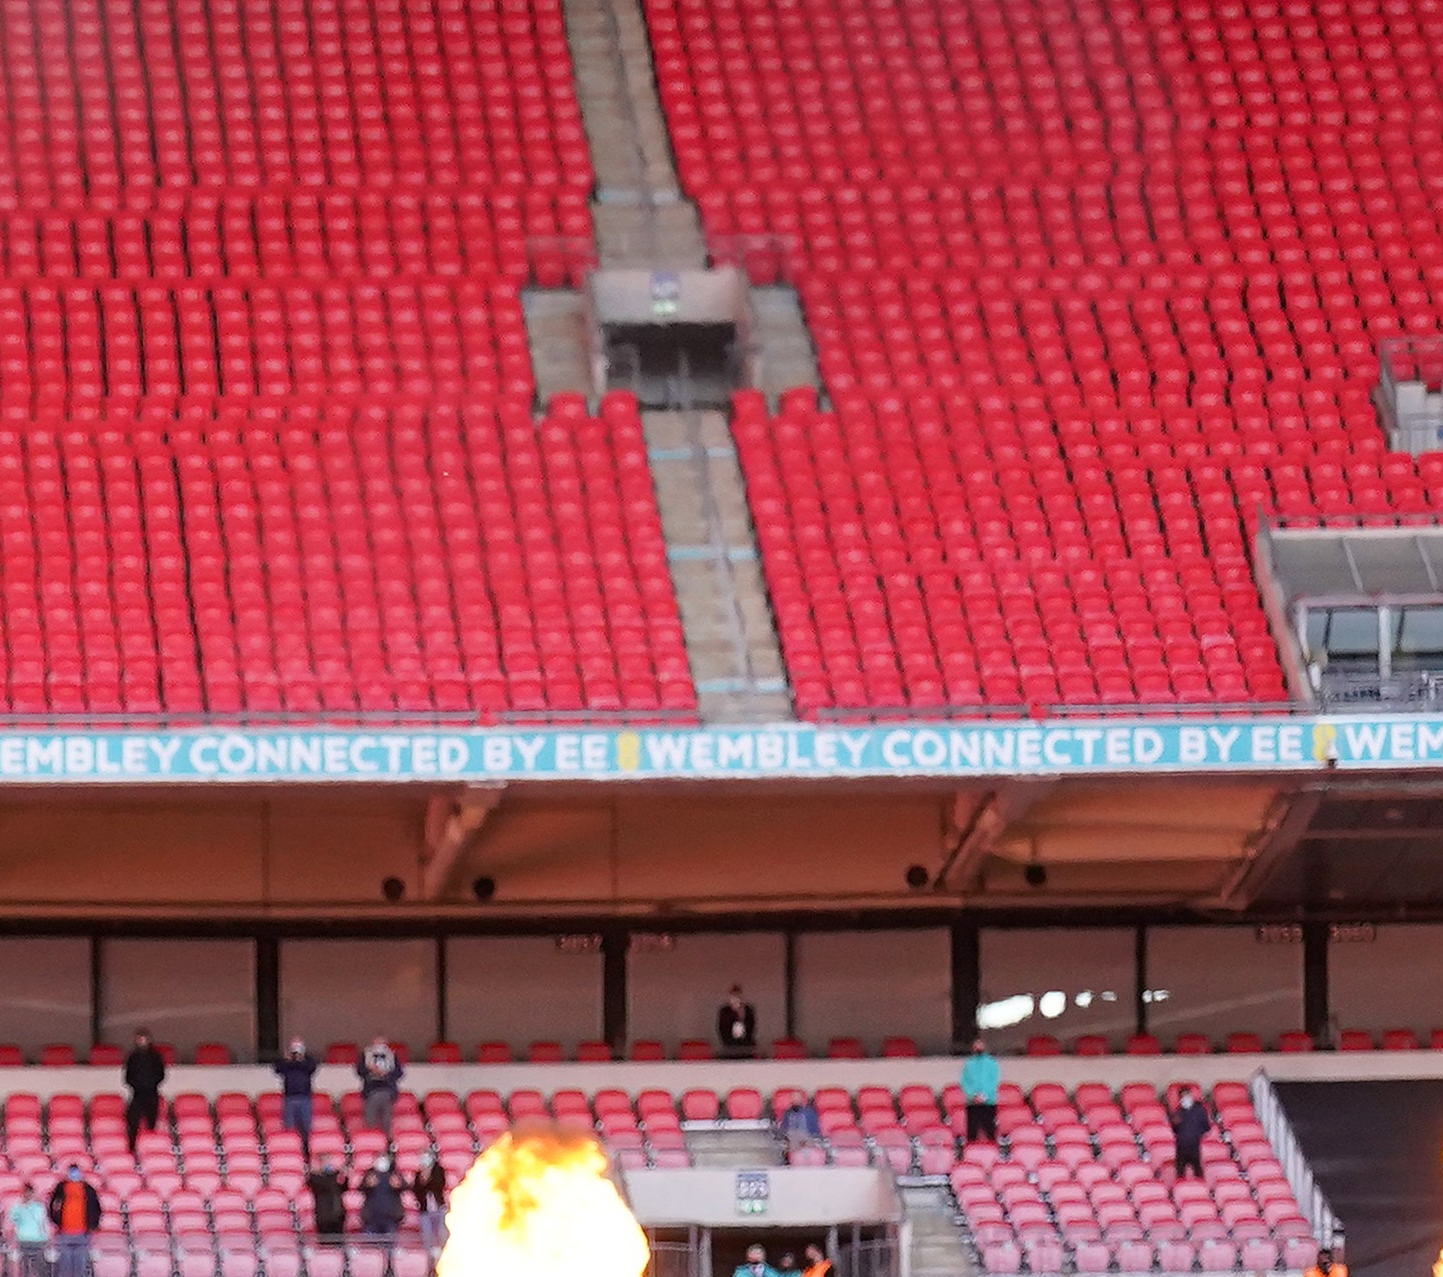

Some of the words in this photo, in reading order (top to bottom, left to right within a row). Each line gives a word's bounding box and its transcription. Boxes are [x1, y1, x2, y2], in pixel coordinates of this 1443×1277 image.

[190, 735, 468, 773] CONNECTED
[484, 734, 544, 772] BY
[555, 733, 607, 769] EE
[649, 729, 873, 768] WEMBLEY
[882, 725, 1163, 766] CONNECTED
[1180, 724, 1241, 763] BY
[1252, 723, 1304, 761] EE
